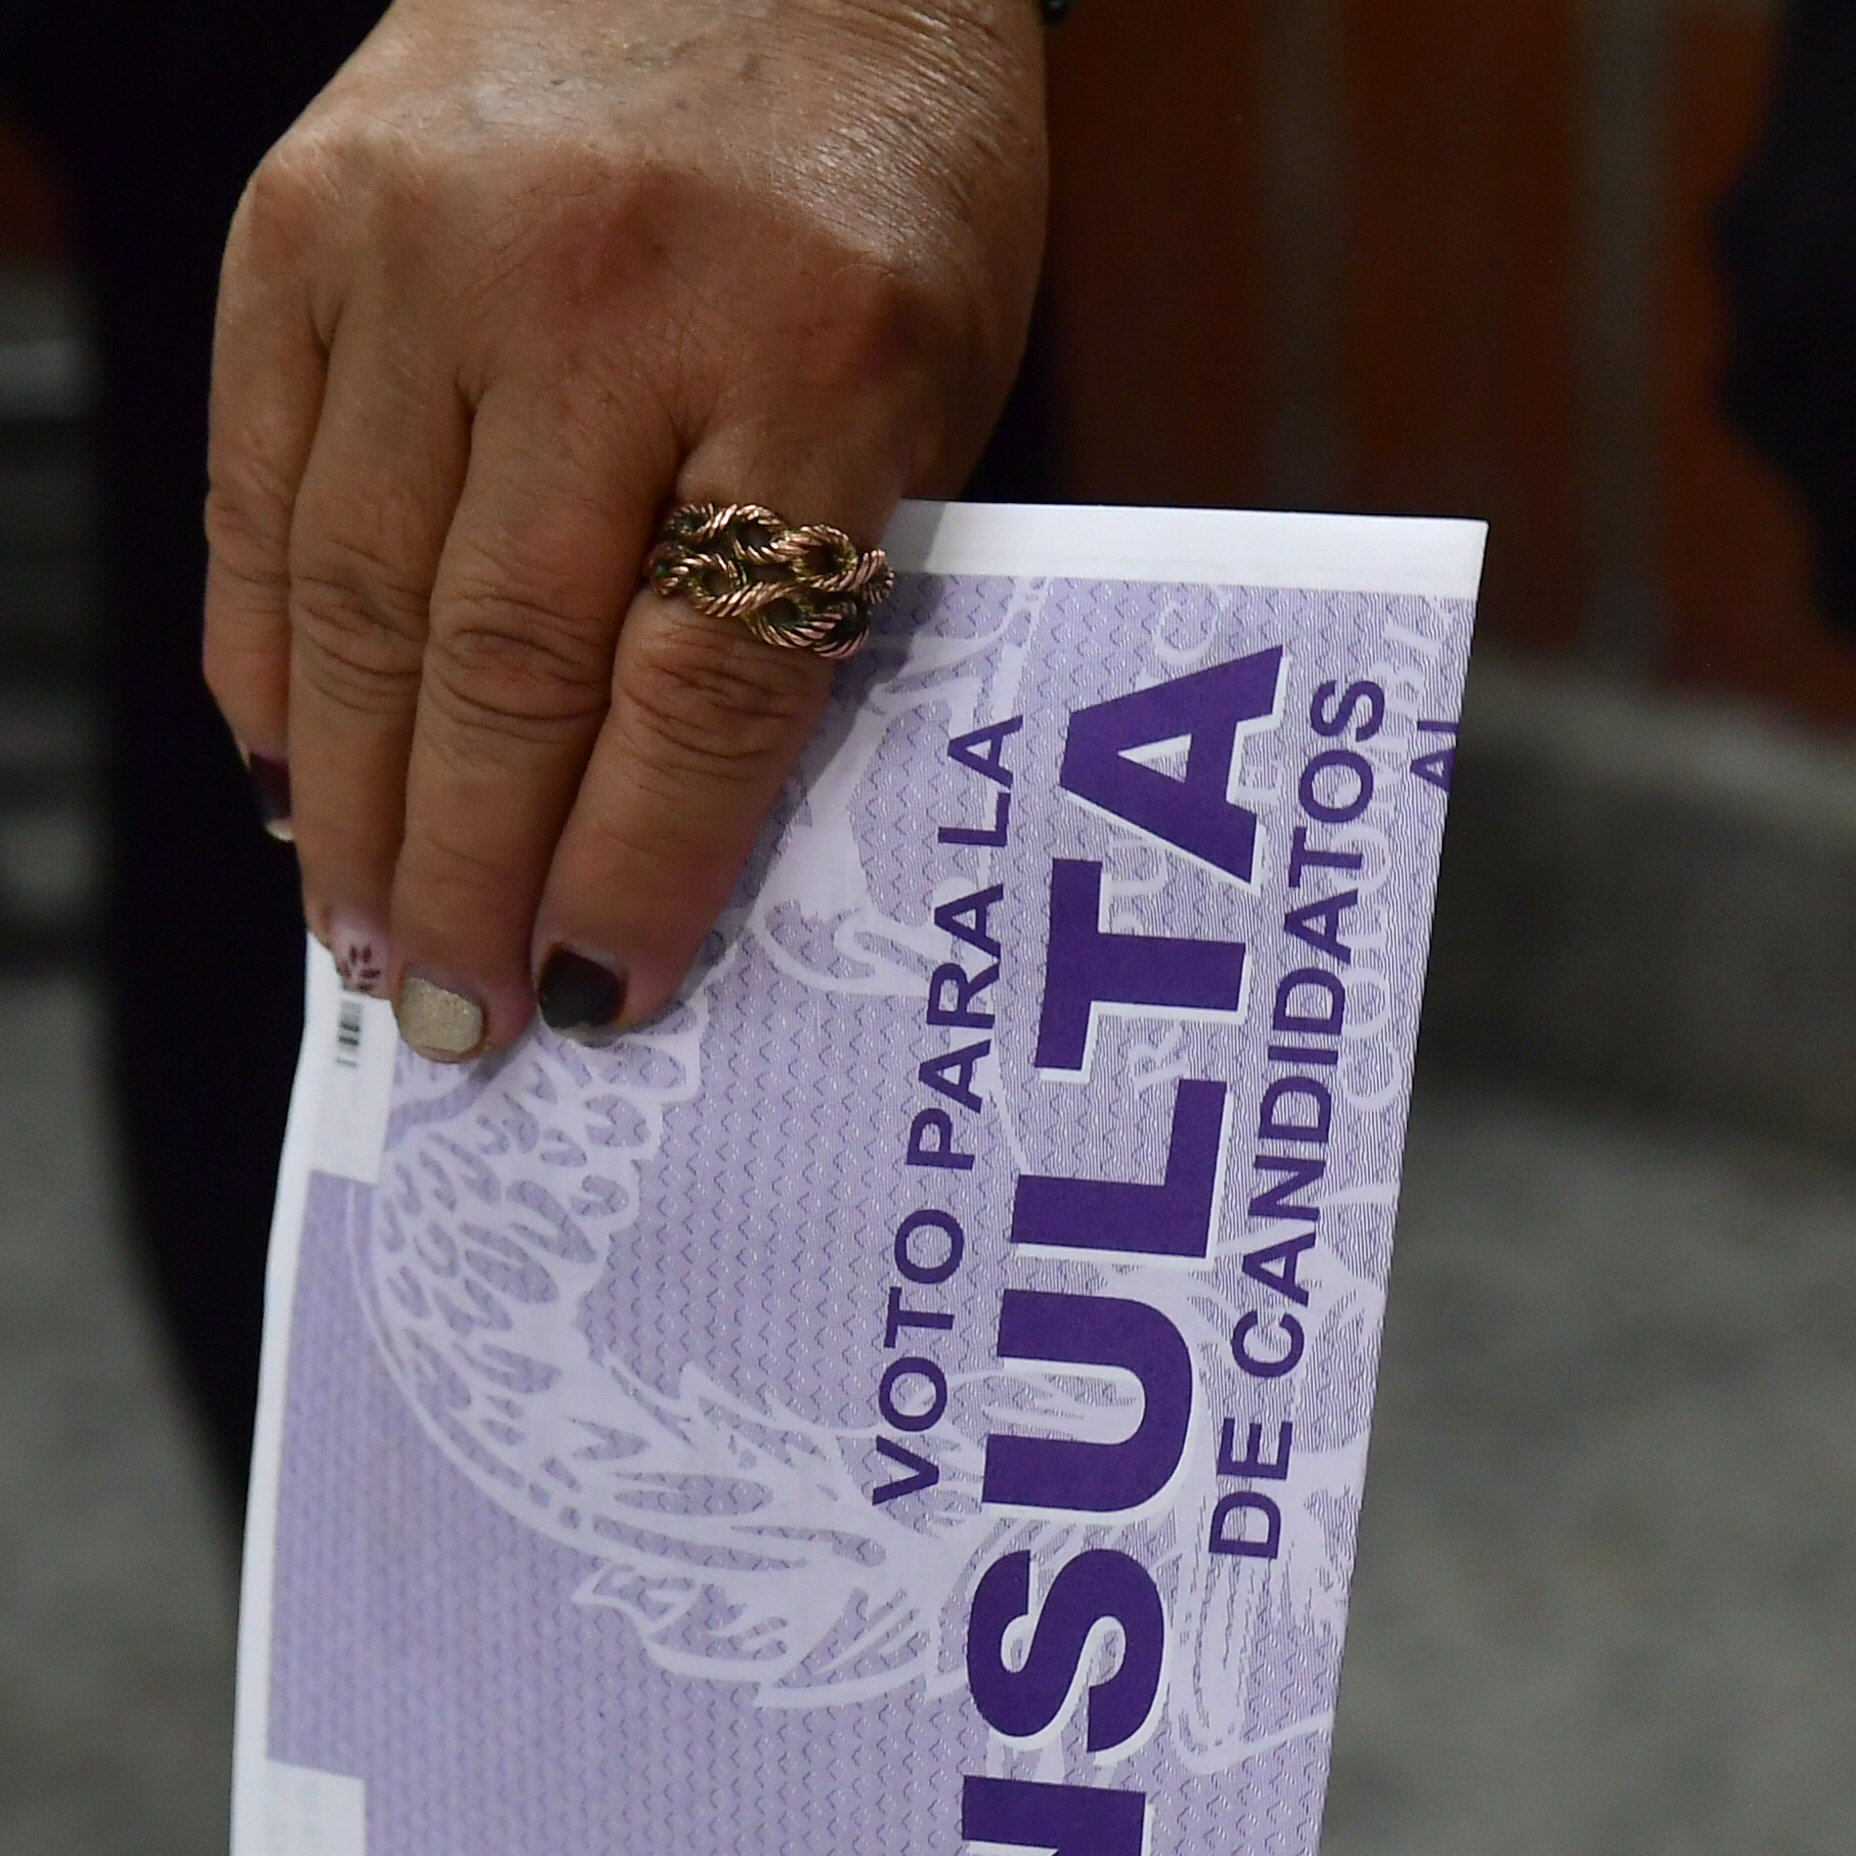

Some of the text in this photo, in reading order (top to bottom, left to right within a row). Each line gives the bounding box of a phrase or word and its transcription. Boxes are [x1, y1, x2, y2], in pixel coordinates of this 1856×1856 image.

[871, 715, 1024, 1506] VOTO PARA LA
[1208, 678, 1386, 1559] DE CANDIDATOS
